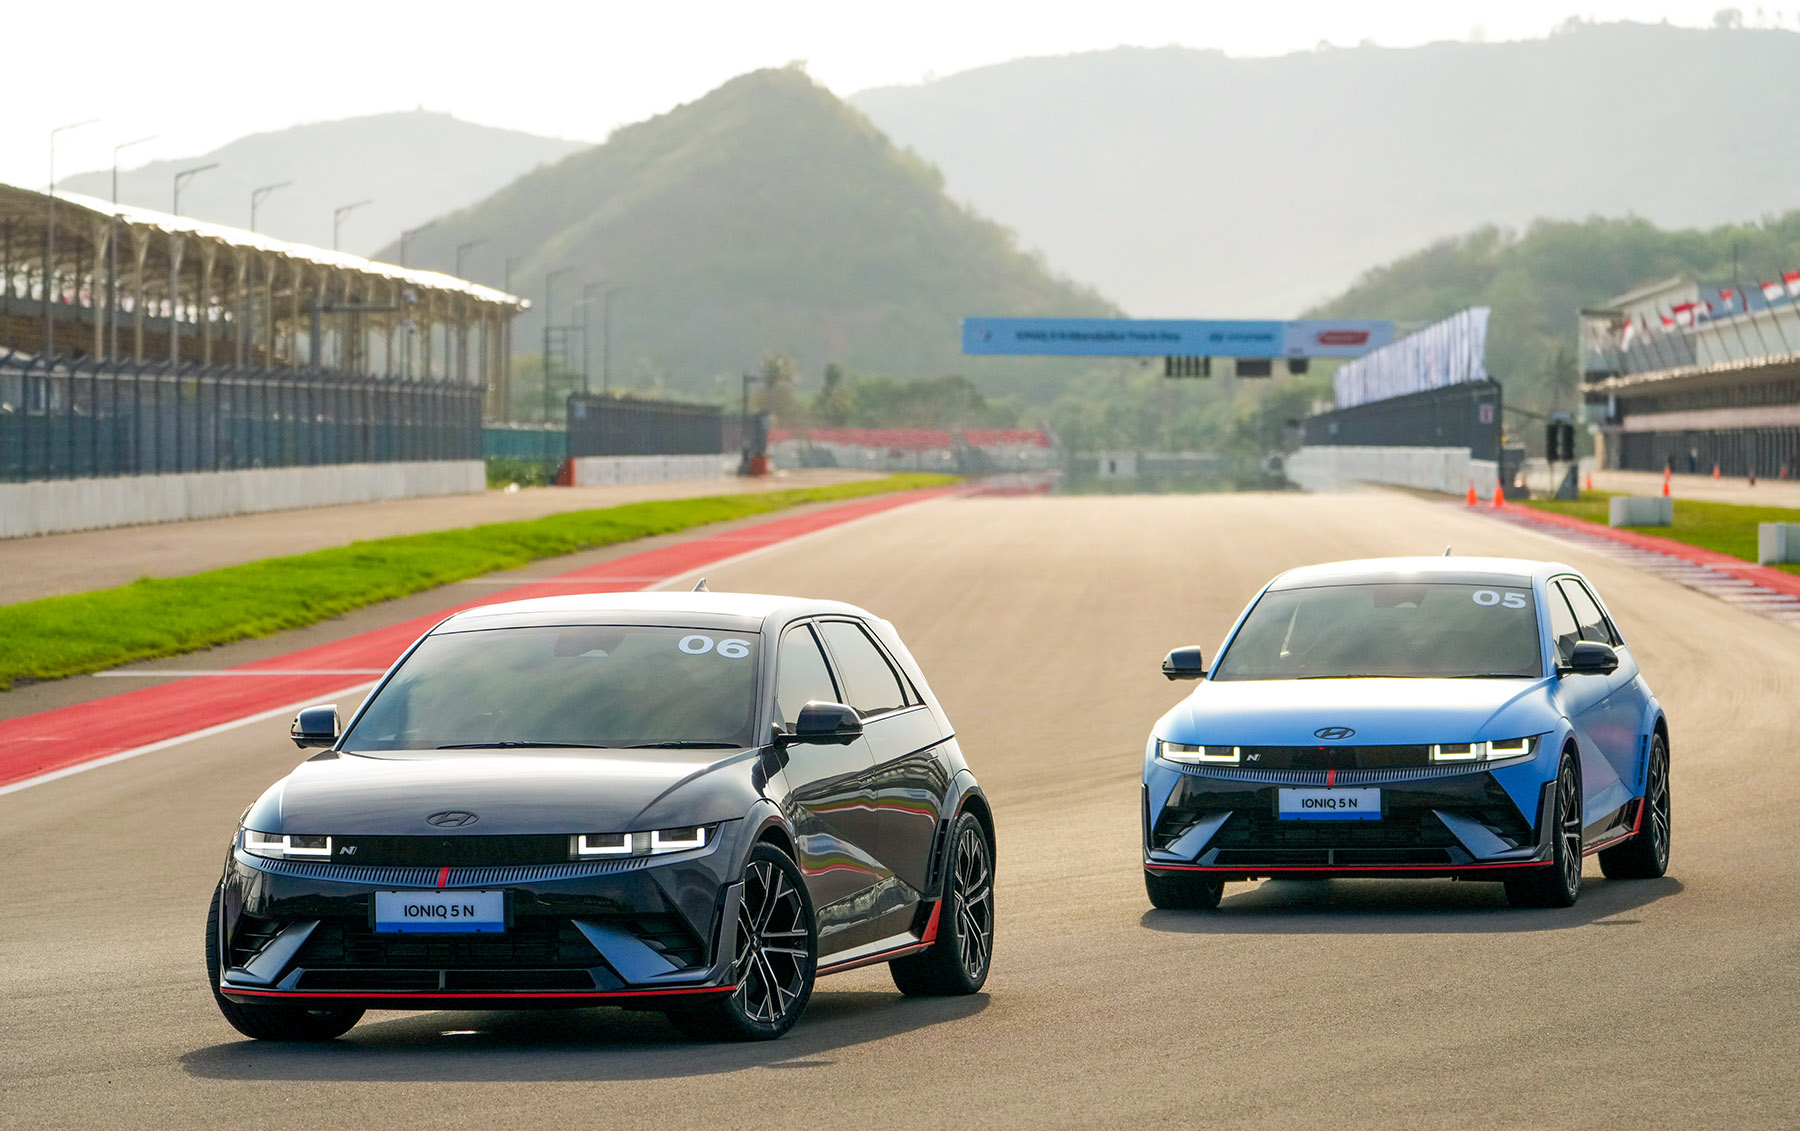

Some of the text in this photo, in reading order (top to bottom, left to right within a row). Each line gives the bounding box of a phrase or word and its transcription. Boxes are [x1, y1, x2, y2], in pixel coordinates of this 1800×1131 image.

[1472, 589, 1526, 609] 05
[678, 634, 751, 659] 06
[1301, 798, 1358, 810] IONIQ 5 N
[404, 905, 475, 919] IONIQ 5 N
